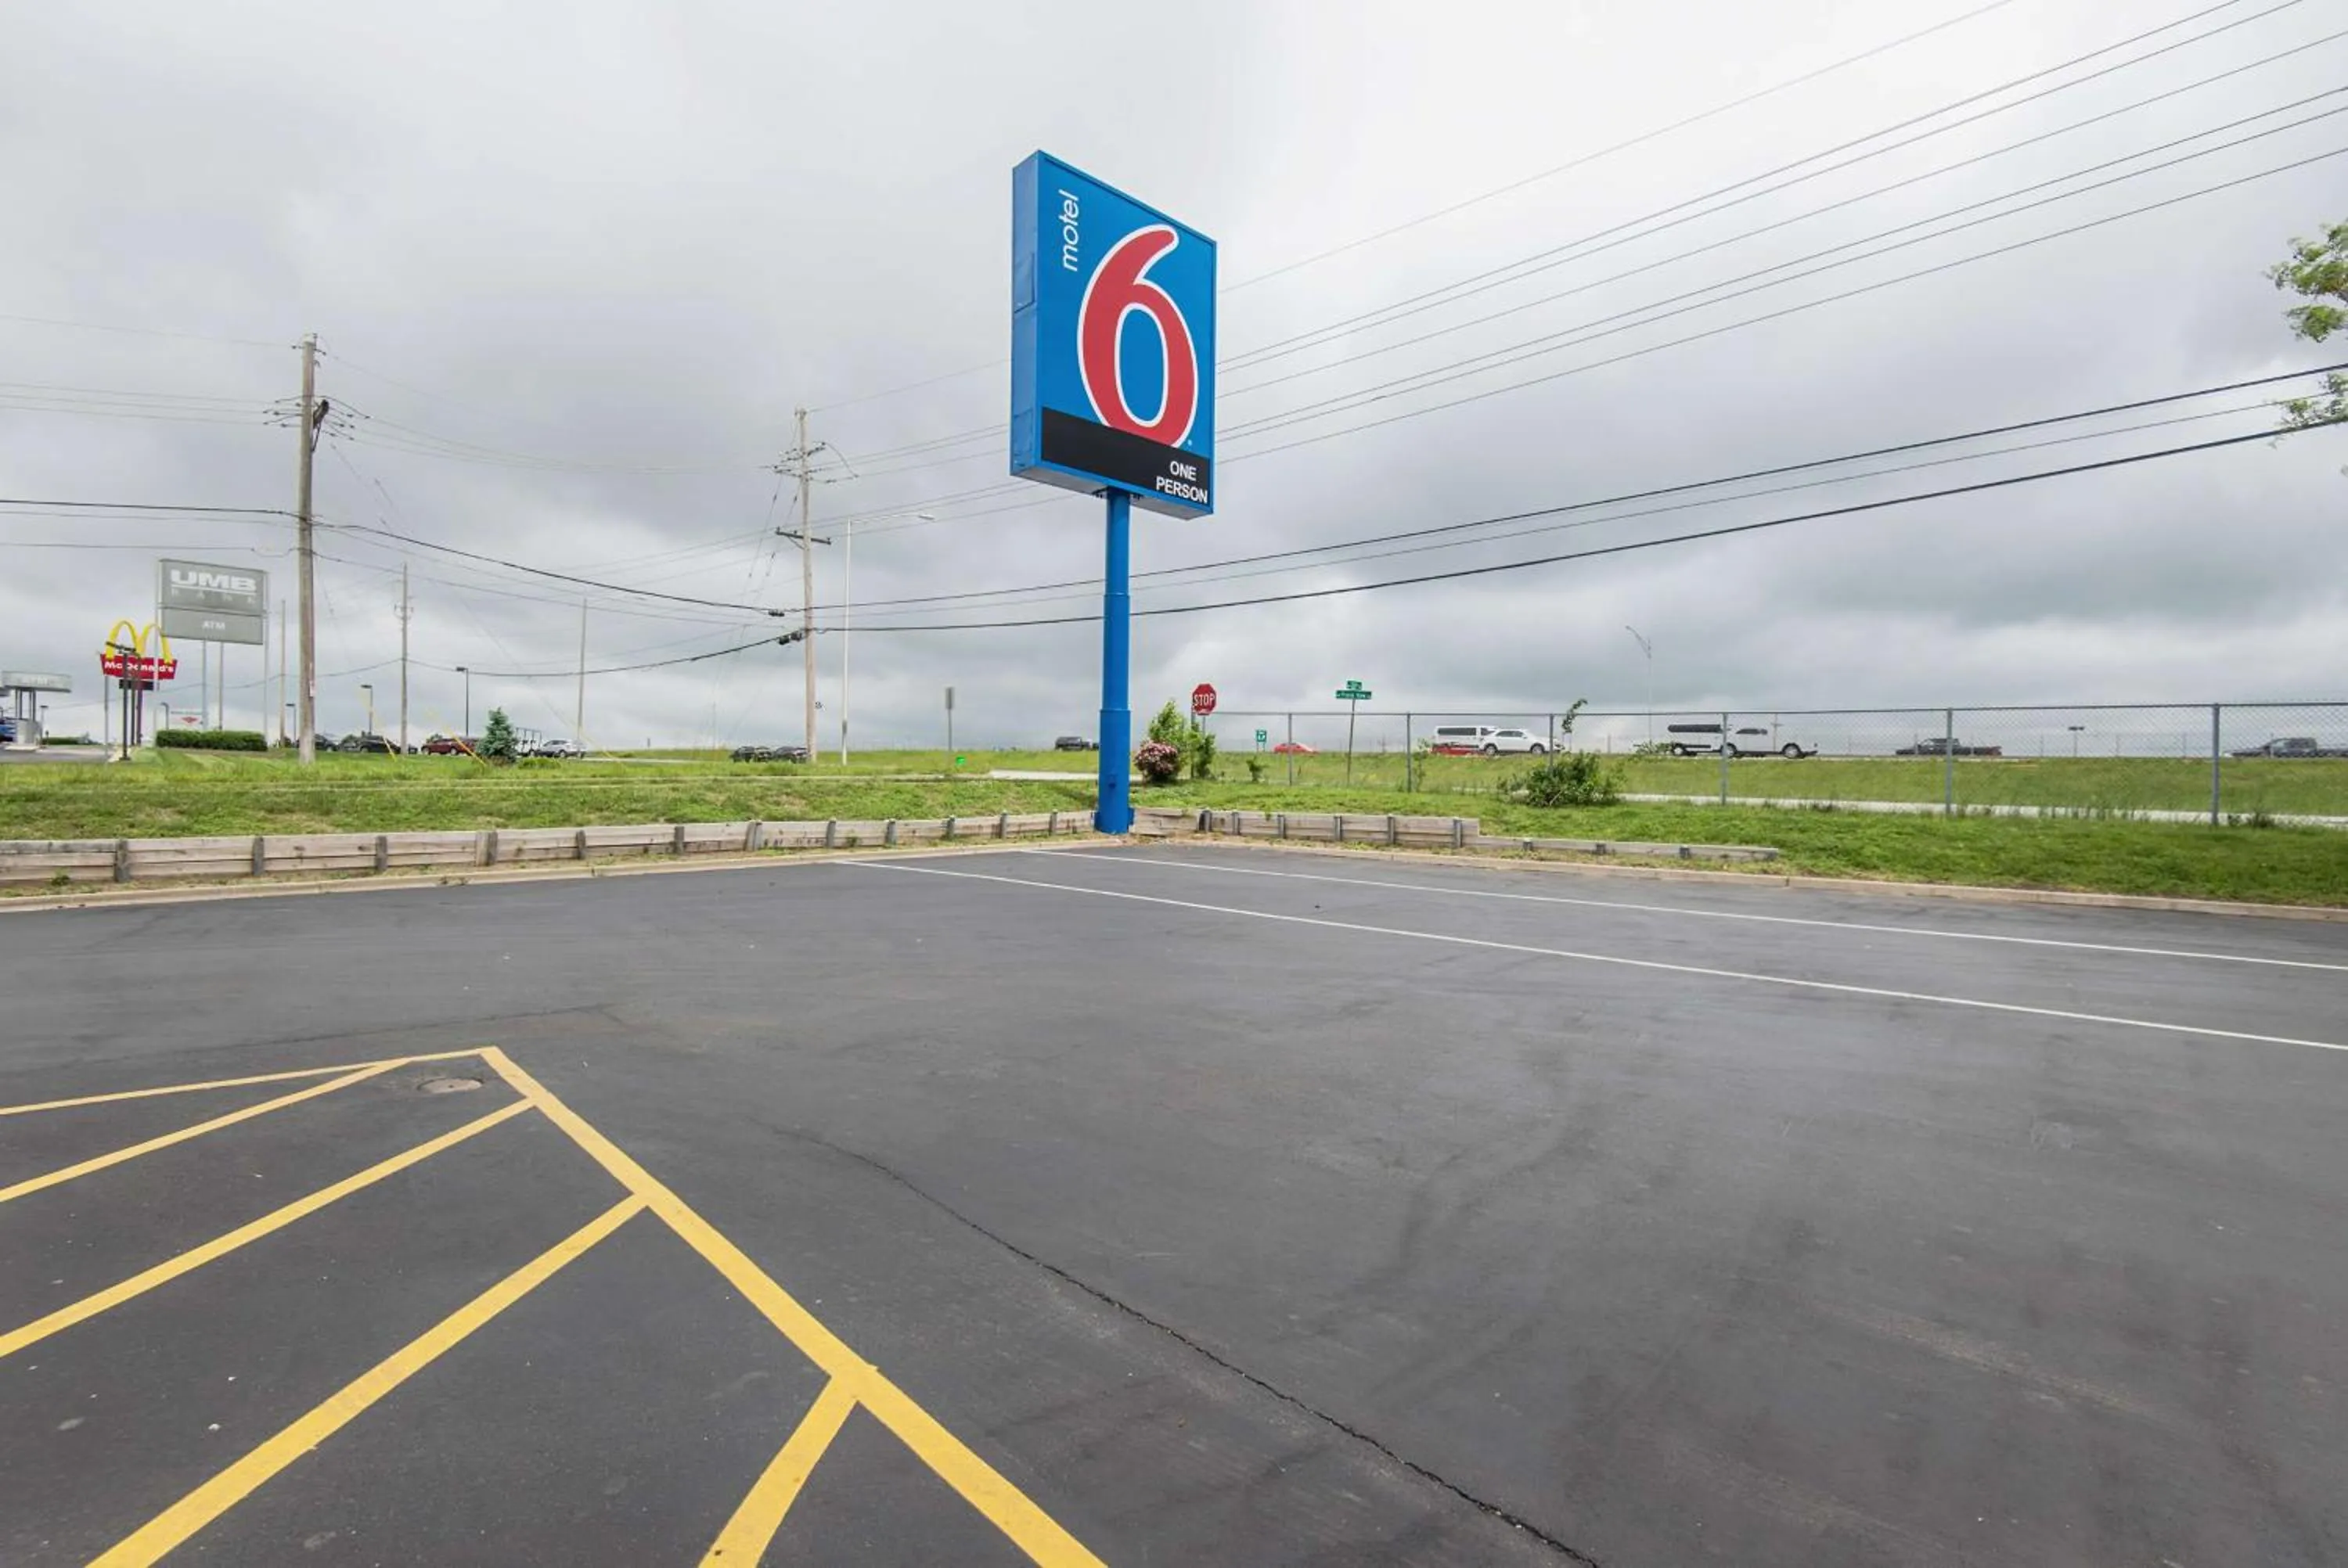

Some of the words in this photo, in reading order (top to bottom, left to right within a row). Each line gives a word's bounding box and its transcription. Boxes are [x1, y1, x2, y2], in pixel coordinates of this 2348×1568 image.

[1058, 189, 1079, 272] motel
[1077, 224, 1199, 448] 6
[1170, 460, 1197, 482] ONE
[1156, 476, 1208, 504] PERSON
[170, 569, 257, 592] UMB
[202, 620, 225, 630] ATM
[1194, 693, 1215, 707] STOP
